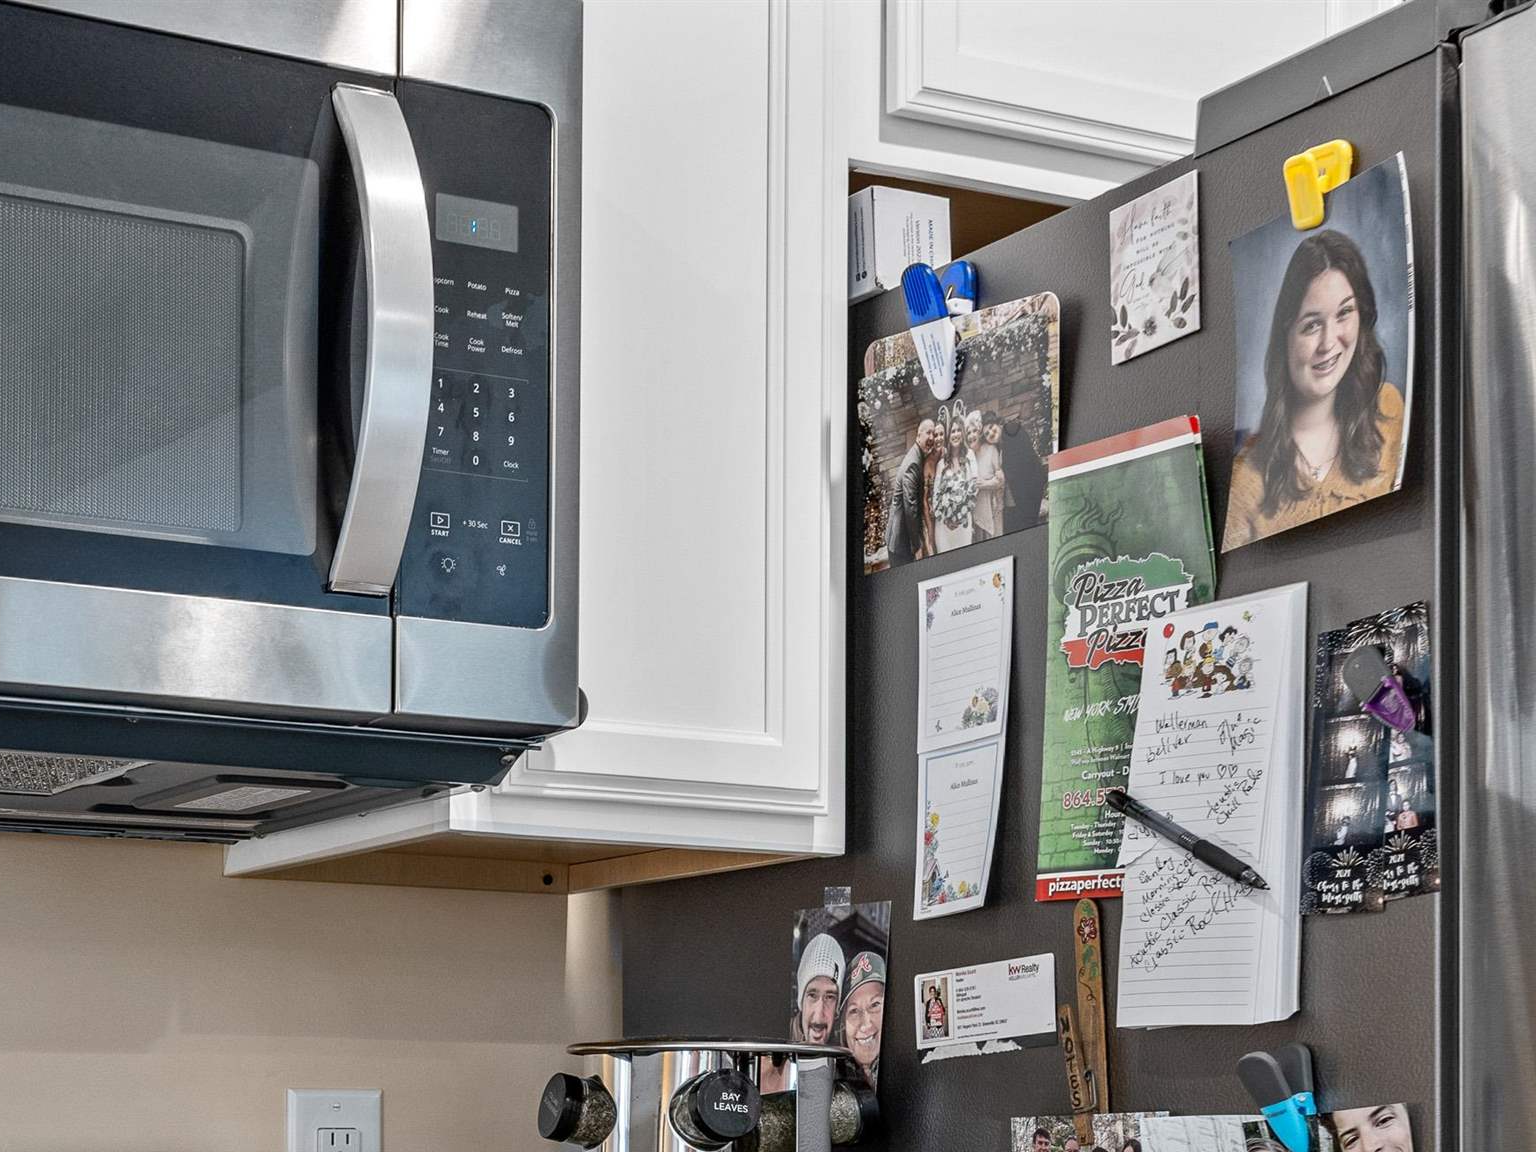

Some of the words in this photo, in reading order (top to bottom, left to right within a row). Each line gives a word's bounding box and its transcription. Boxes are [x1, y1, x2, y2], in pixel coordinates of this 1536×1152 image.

[466, 280, 488, 292] Potato
[505, 287, 520, 297] Pizza
[466, 309, 488, 321] Reheat
[505, 319, 519, 329] Melt
[469, 337, 484, 347] Cook
[467, 344, 486, 354] Power
[500, 345, 524, 356] Defrost
[437, 378, 443, 389] 1
[473, 383, 480, 394] 2
[508, 388, 515, 399] 3
[437, 402, 444, 413] 4
[473, 407, 479, 418] 5
[508, 412, 515, 422] 6
[437, 426, 444, 437] 7
[473, 430, 479, 441] 8
[507, 435, 514, 446] 9
[432, 447, 450, 457] Timer
[473, 455, 479, 466] 0
[503, 460, 520, 470] Clock
[478, 521, 489, 529] Sec
[431, 529, 450, 537] START
[499, 537, 522, 546] CANCEL
[1073, 572, 1146, 610] Pizza
[1077, 588, 1181, 637] PERFECT
[1084, 700, 1114, 725] YORK
[1081, 769, 1114, 781] Carryout
[1159, 771, 1166, 785] I
[1173, 771, 1191, 784] love
[1021, 963, 1040, 975] Realty
[721, 1092, 741, 1101] BAY
[714, 1101, 749, 1114] LEAVES
